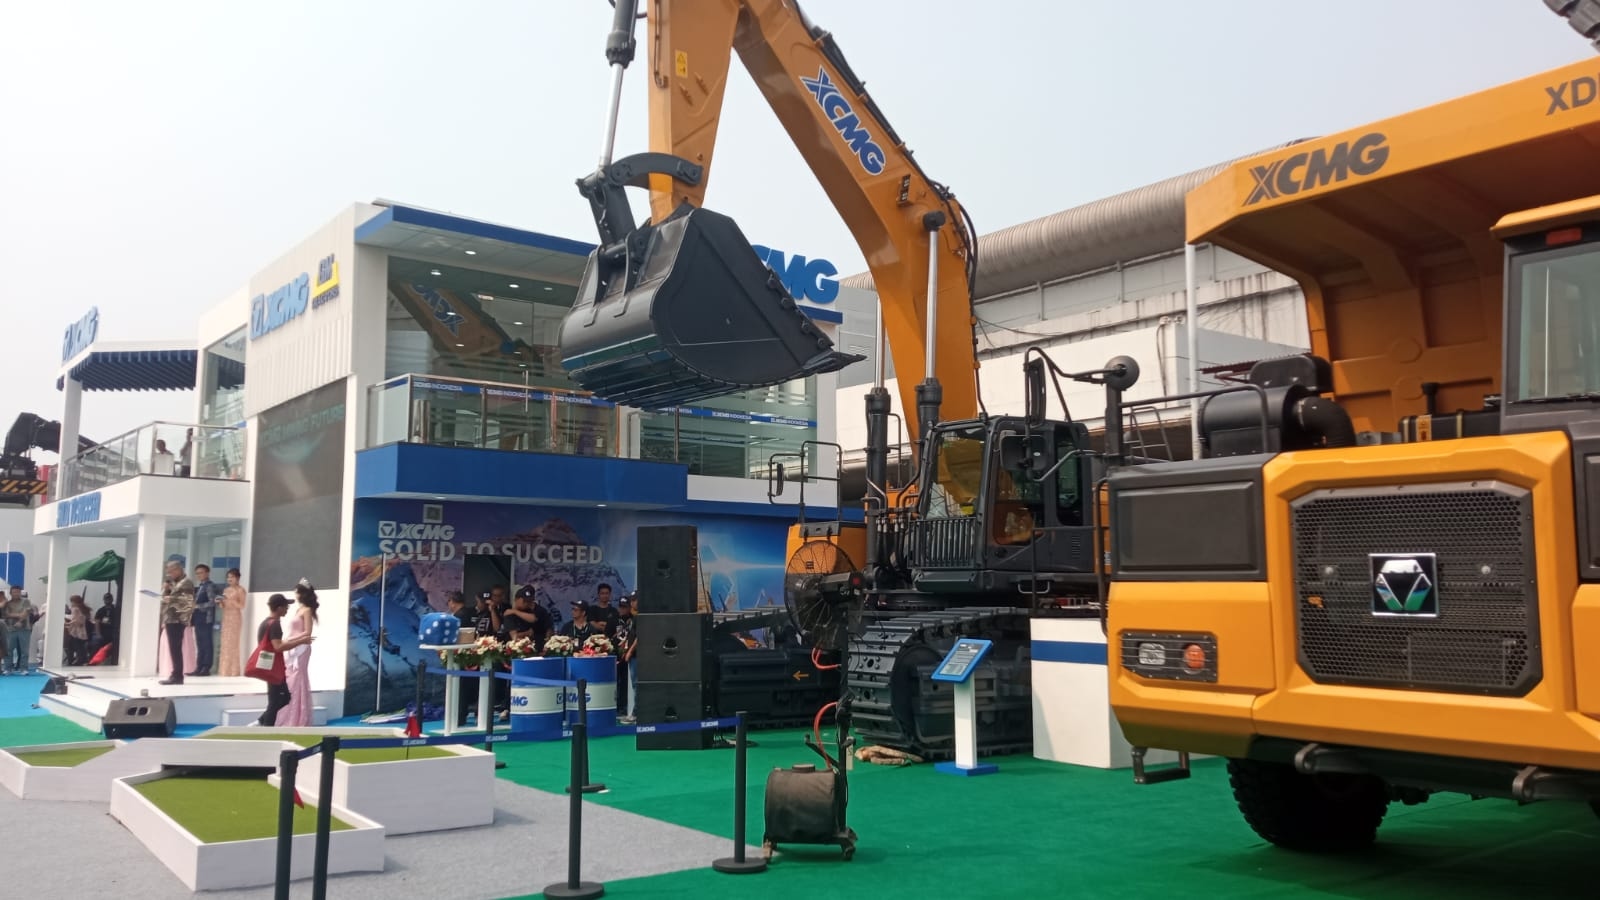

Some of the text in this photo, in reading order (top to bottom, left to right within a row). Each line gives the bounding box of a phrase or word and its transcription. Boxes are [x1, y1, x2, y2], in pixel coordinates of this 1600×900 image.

[1544, 72, 1600, 116] XD
[799, 64, 886, 176] XCMG
[1241, 132, 1390, 207] XCMG
[378, 539, 604, 565] SOLID TO SUCCEED
[397, 523, 456, 541] XCMG
